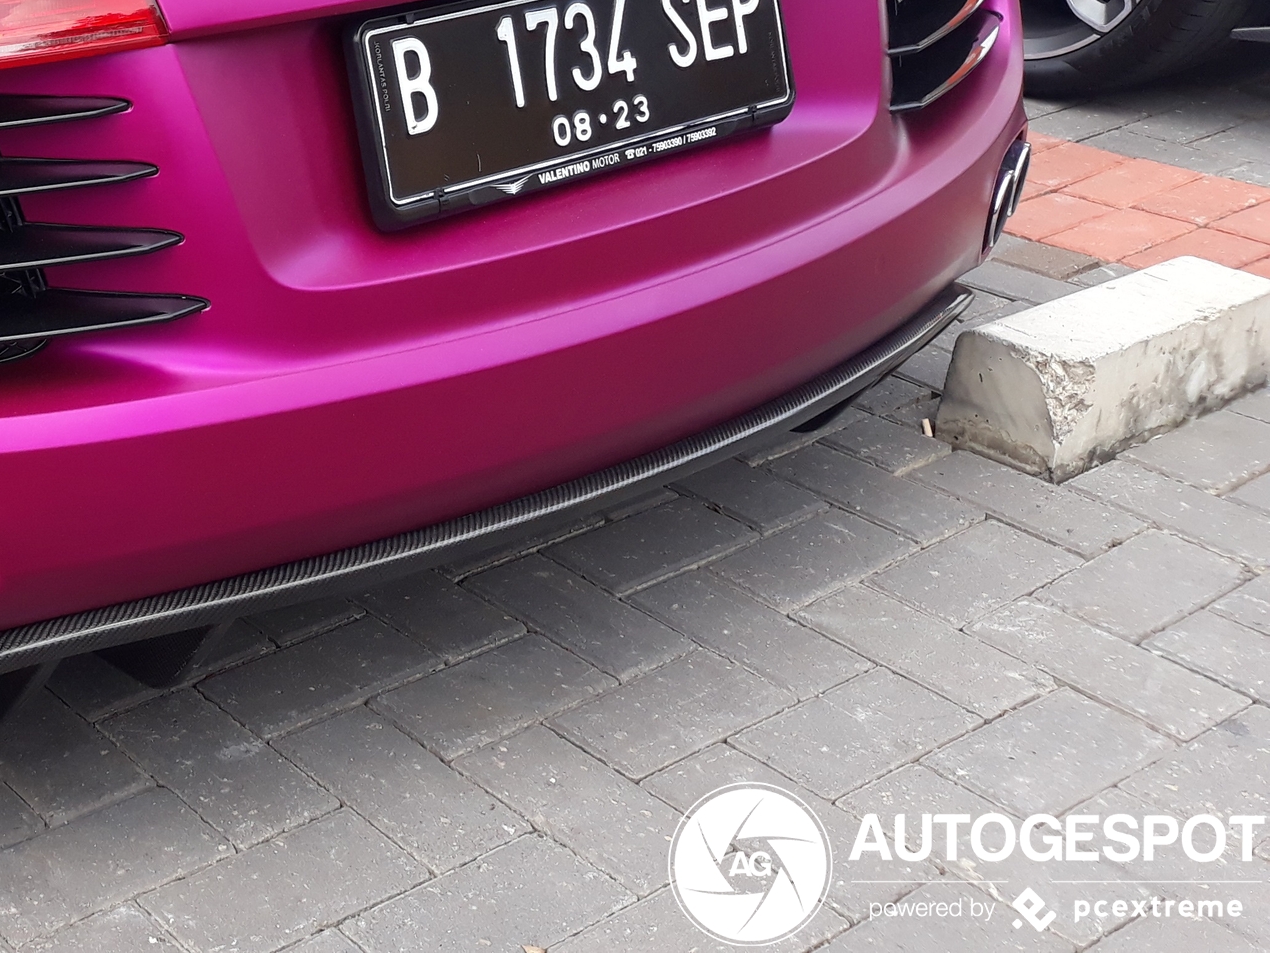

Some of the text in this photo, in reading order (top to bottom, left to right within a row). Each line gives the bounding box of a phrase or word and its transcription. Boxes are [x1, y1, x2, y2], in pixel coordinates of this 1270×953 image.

[390, 36, 439, 135] B
[538, 161, 591, 184] VALENTINO
[592, 153, 621, 169] MOTOR
